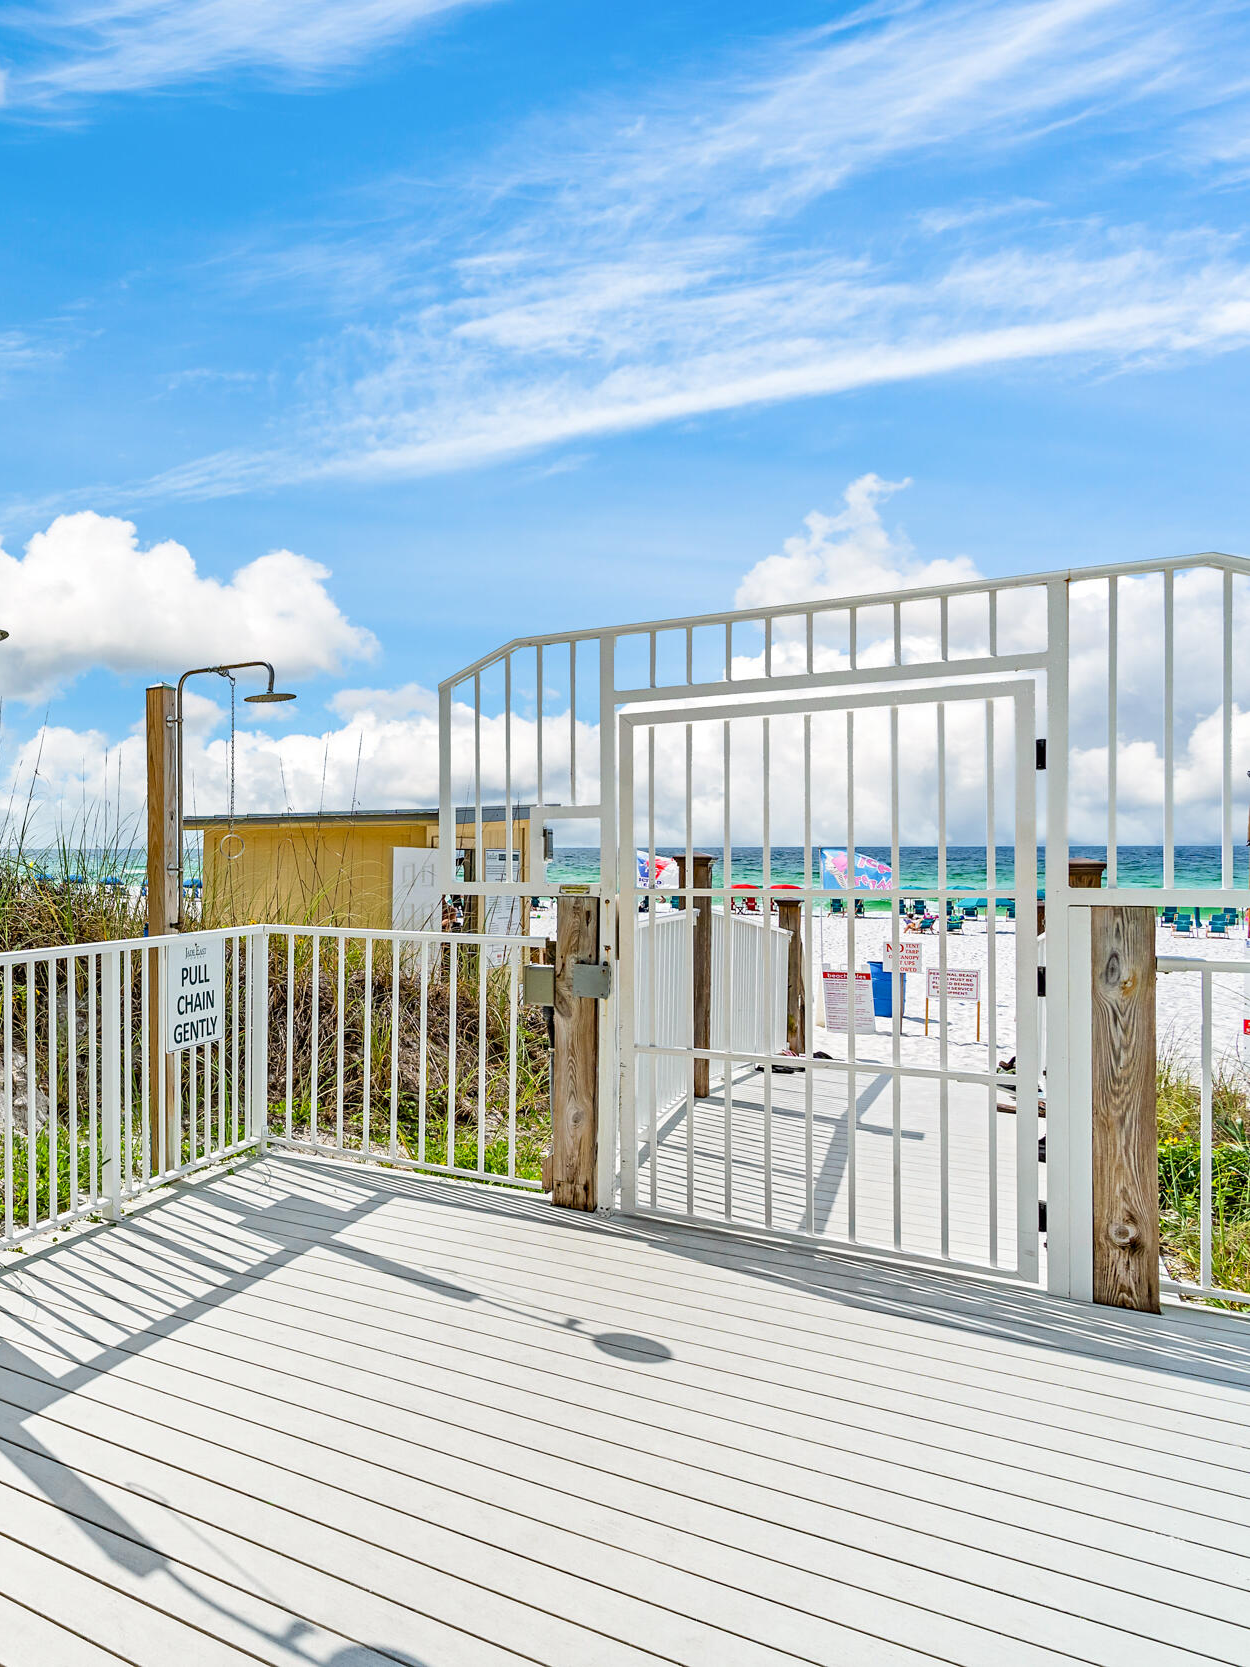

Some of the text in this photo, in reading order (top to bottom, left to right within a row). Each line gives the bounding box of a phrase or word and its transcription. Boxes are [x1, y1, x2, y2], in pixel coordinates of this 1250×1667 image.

[181, 964, 210, 987] PULL
[177, 990, 215, 1016] CHAIN
[173, 1015, 218, 1044] GENTLY
